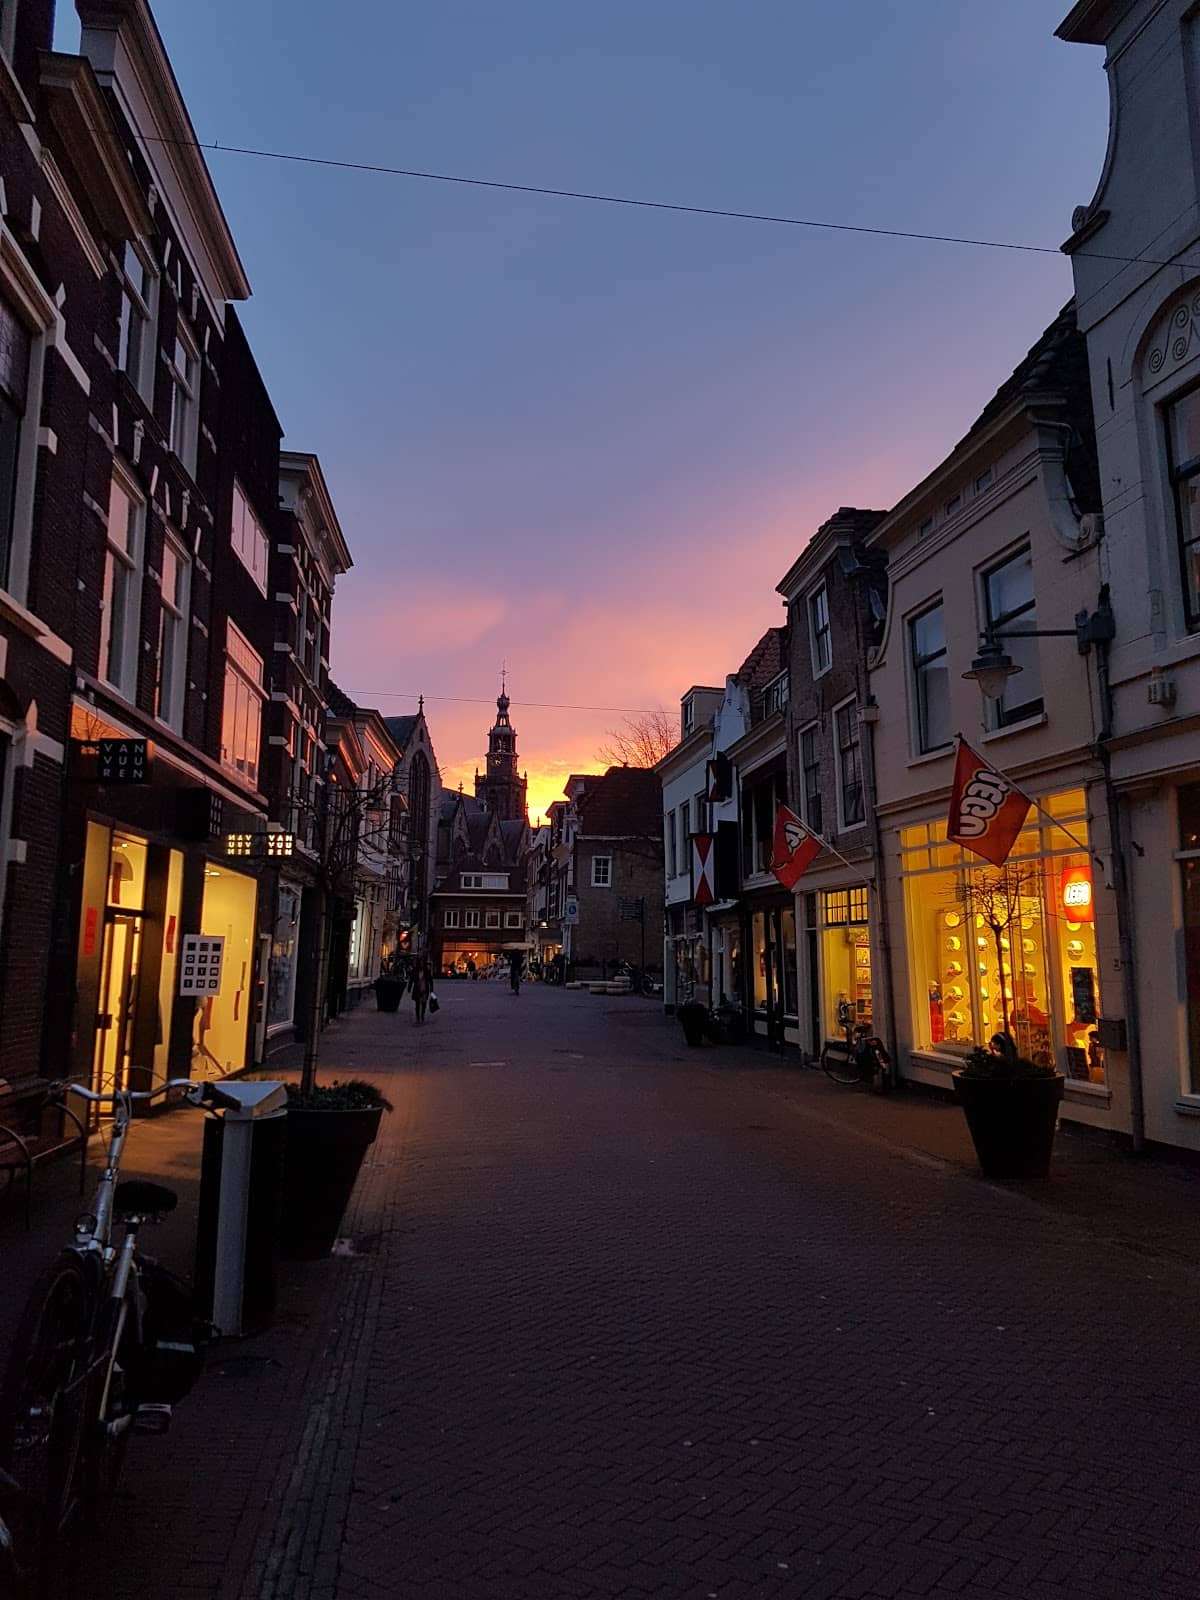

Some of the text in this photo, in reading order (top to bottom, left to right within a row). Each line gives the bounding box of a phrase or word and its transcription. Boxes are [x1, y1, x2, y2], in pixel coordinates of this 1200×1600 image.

[103, 743, 145, 754] VAN
[103, 755, 144, 766] VUU
[103, 768, 144, 779] REN
[268, 834, 293, 842] VAN
[268, 841, 292, 849] VUU
[268, 848, 292, 856] REN
[1065, 882, 1090, 905] LEGO
